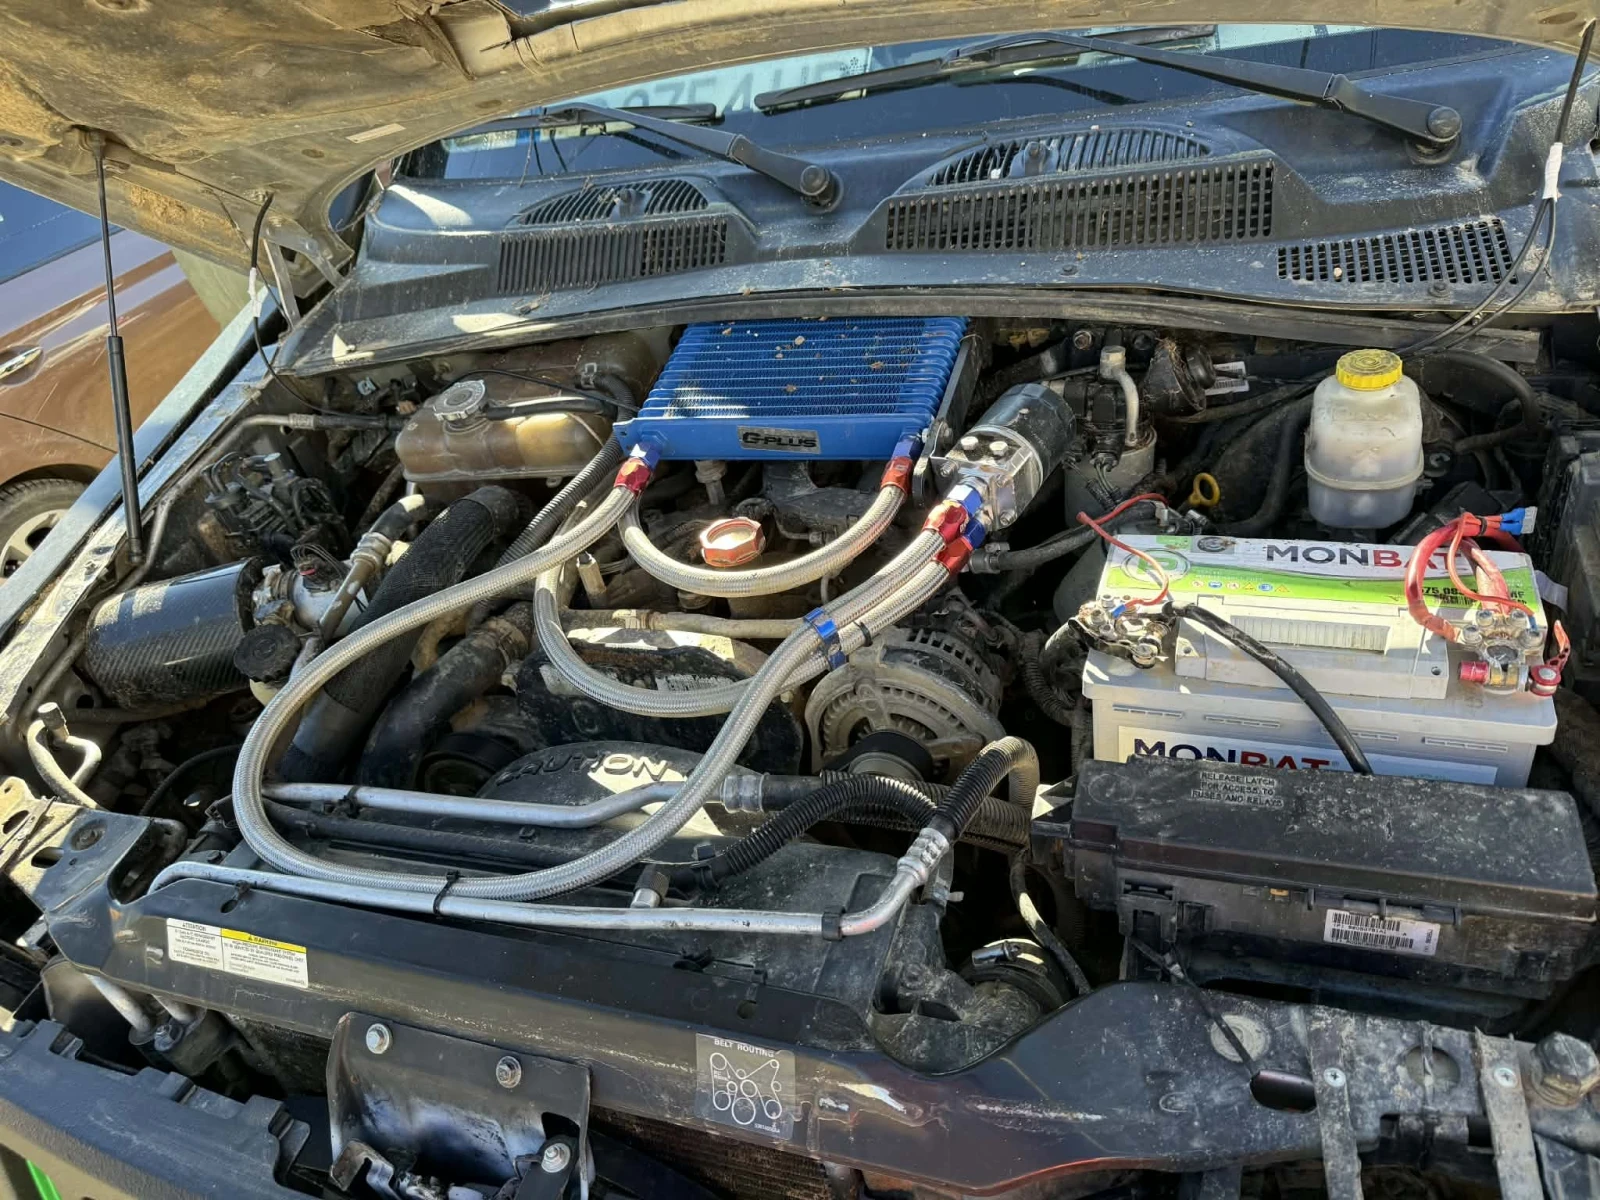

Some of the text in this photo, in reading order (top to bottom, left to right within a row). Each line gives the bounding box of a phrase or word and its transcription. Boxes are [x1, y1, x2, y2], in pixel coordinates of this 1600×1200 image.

[496, 750, 669, 786] CAUTION
[1200, 771, 1276, 787] RELEASE LATCH
[1201, 780, 1274, 796] FOR ACCESS TO
[1191, 790, 1283, 807] FUSES AND RELAYS
[714, 1038, 775, 1058] BELT ROUTING
